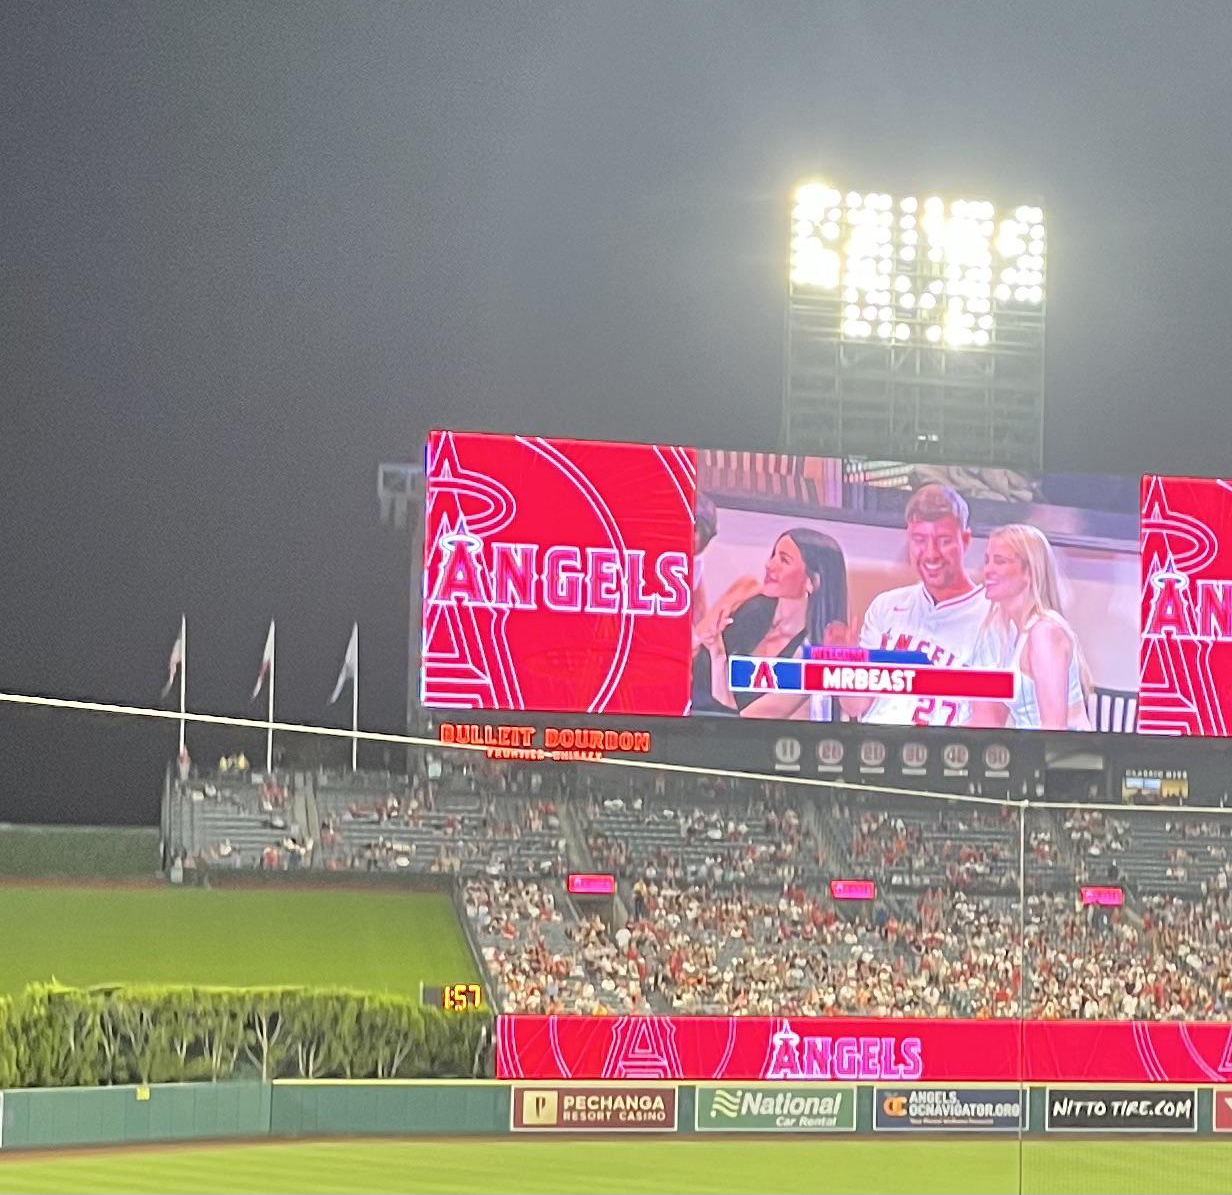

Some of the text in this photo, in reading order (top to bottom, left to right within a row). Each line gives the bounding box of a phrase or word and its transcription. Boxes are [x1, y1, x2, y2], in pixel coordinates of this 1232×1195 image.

[438, 514, 688, 616] ANGELS
[823, 667, 915, 692] MRBEAST
[445, 984, 481, 1011] 1:57
[765, 1018, 922, 1079] ANGELS
[563, 1095, 665, 1111] PECHANGA
[741, 1091, 843, 1117] National
[908, 1102, 1021, 1118] OCNAVIGATOR.ORG
[1052, 1096, 1191, 1119] NITTO TIRE.COM
[775, 1115, 838, 1127] Car Rental
